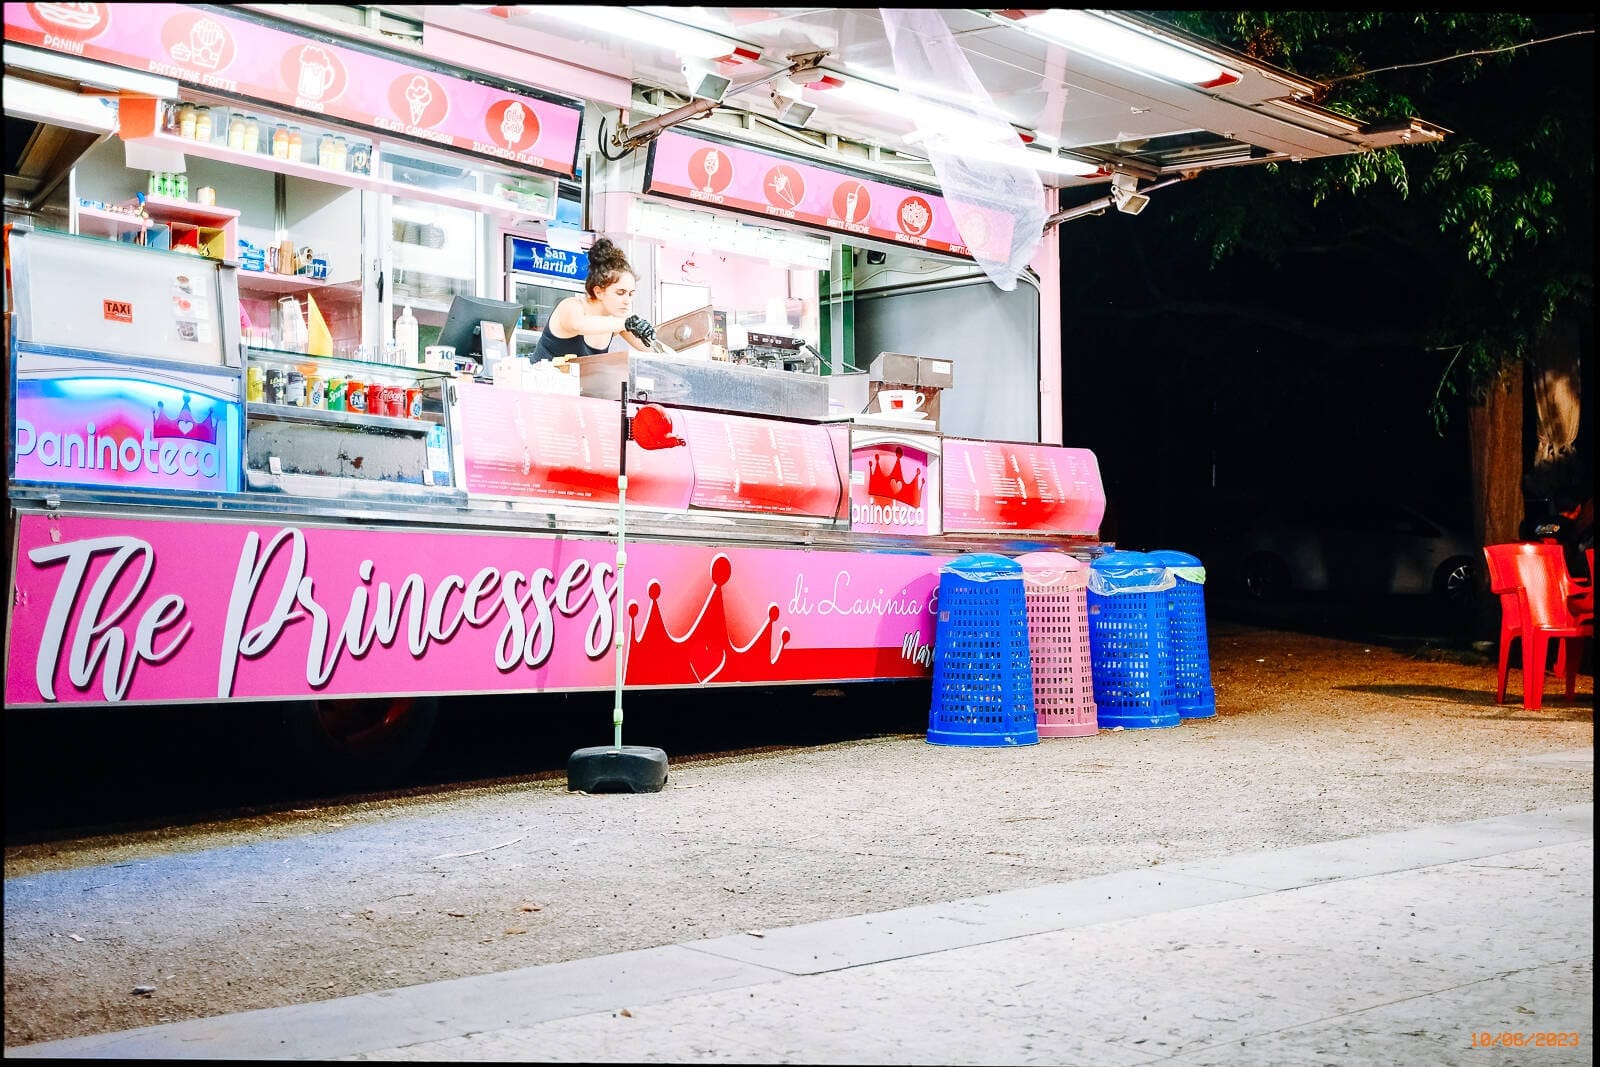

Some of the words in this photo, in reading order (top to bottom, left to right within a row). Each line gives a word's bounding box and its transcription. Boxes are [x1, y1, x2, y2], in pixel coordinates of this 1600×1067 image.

[43, 34, 83, 54] PANINI
[149, 61, 200, 84] PATATINE
[472, 141, 516, 161] ZUCCHERO
[516, 152, 544, 167] FILATO
[690, 189, 724, 204] APERITIVO
[766, 205, 795, 218] FRITTURA
[544, 246, 567, 261] San
[533, 256, 578, 275] Martino
[105, 302, 131, 315] TAXI
[439, 350, 453, 360] 10
[15, 418, 220, 478] Paninoteca
[852, 497, 924, 526] aninoteca
[788, 573, 814, 616] di
[818, 570, 922, 616] Lavinia
[28, 535, 192, 702] The
[217, 527, 618, 699] Princesses
